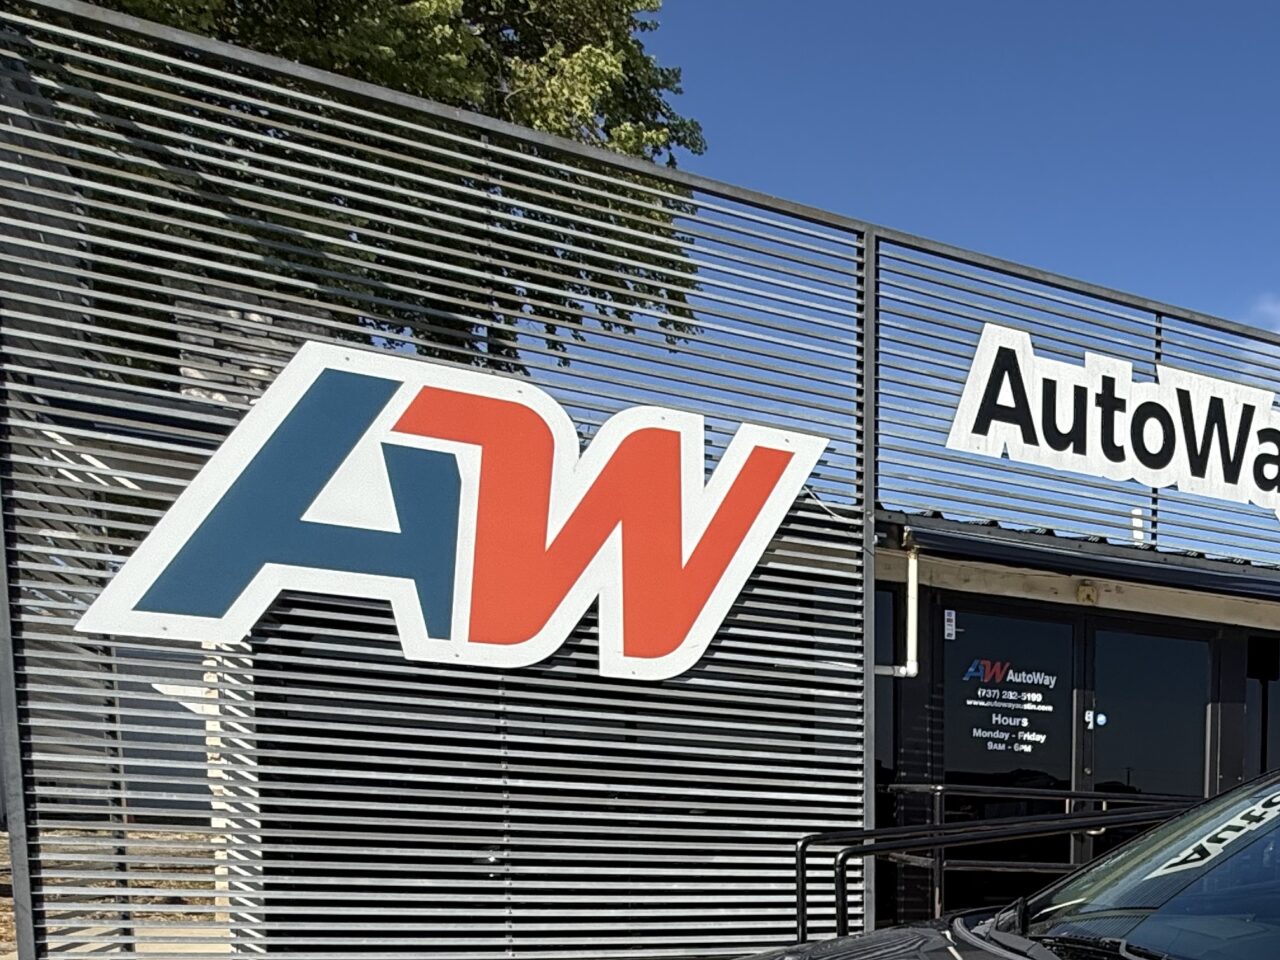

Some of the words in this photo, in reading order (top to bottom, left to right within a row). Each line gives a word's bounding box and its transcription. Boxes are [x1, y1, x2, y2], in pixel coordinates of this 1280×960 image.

[131, 367, 795, 659] AW
[962, 659, 1010, 683] AW
[1006, 669, 1057, 688] AutoWay
[977, 687, 1000, 699] (737)
[992, 713, 1028, 727] Hours
[972, 728, 1010, 740] Monday
[1018, 731, 1046, 743] Friday
[987, 741, 1006, 751] 9AM
